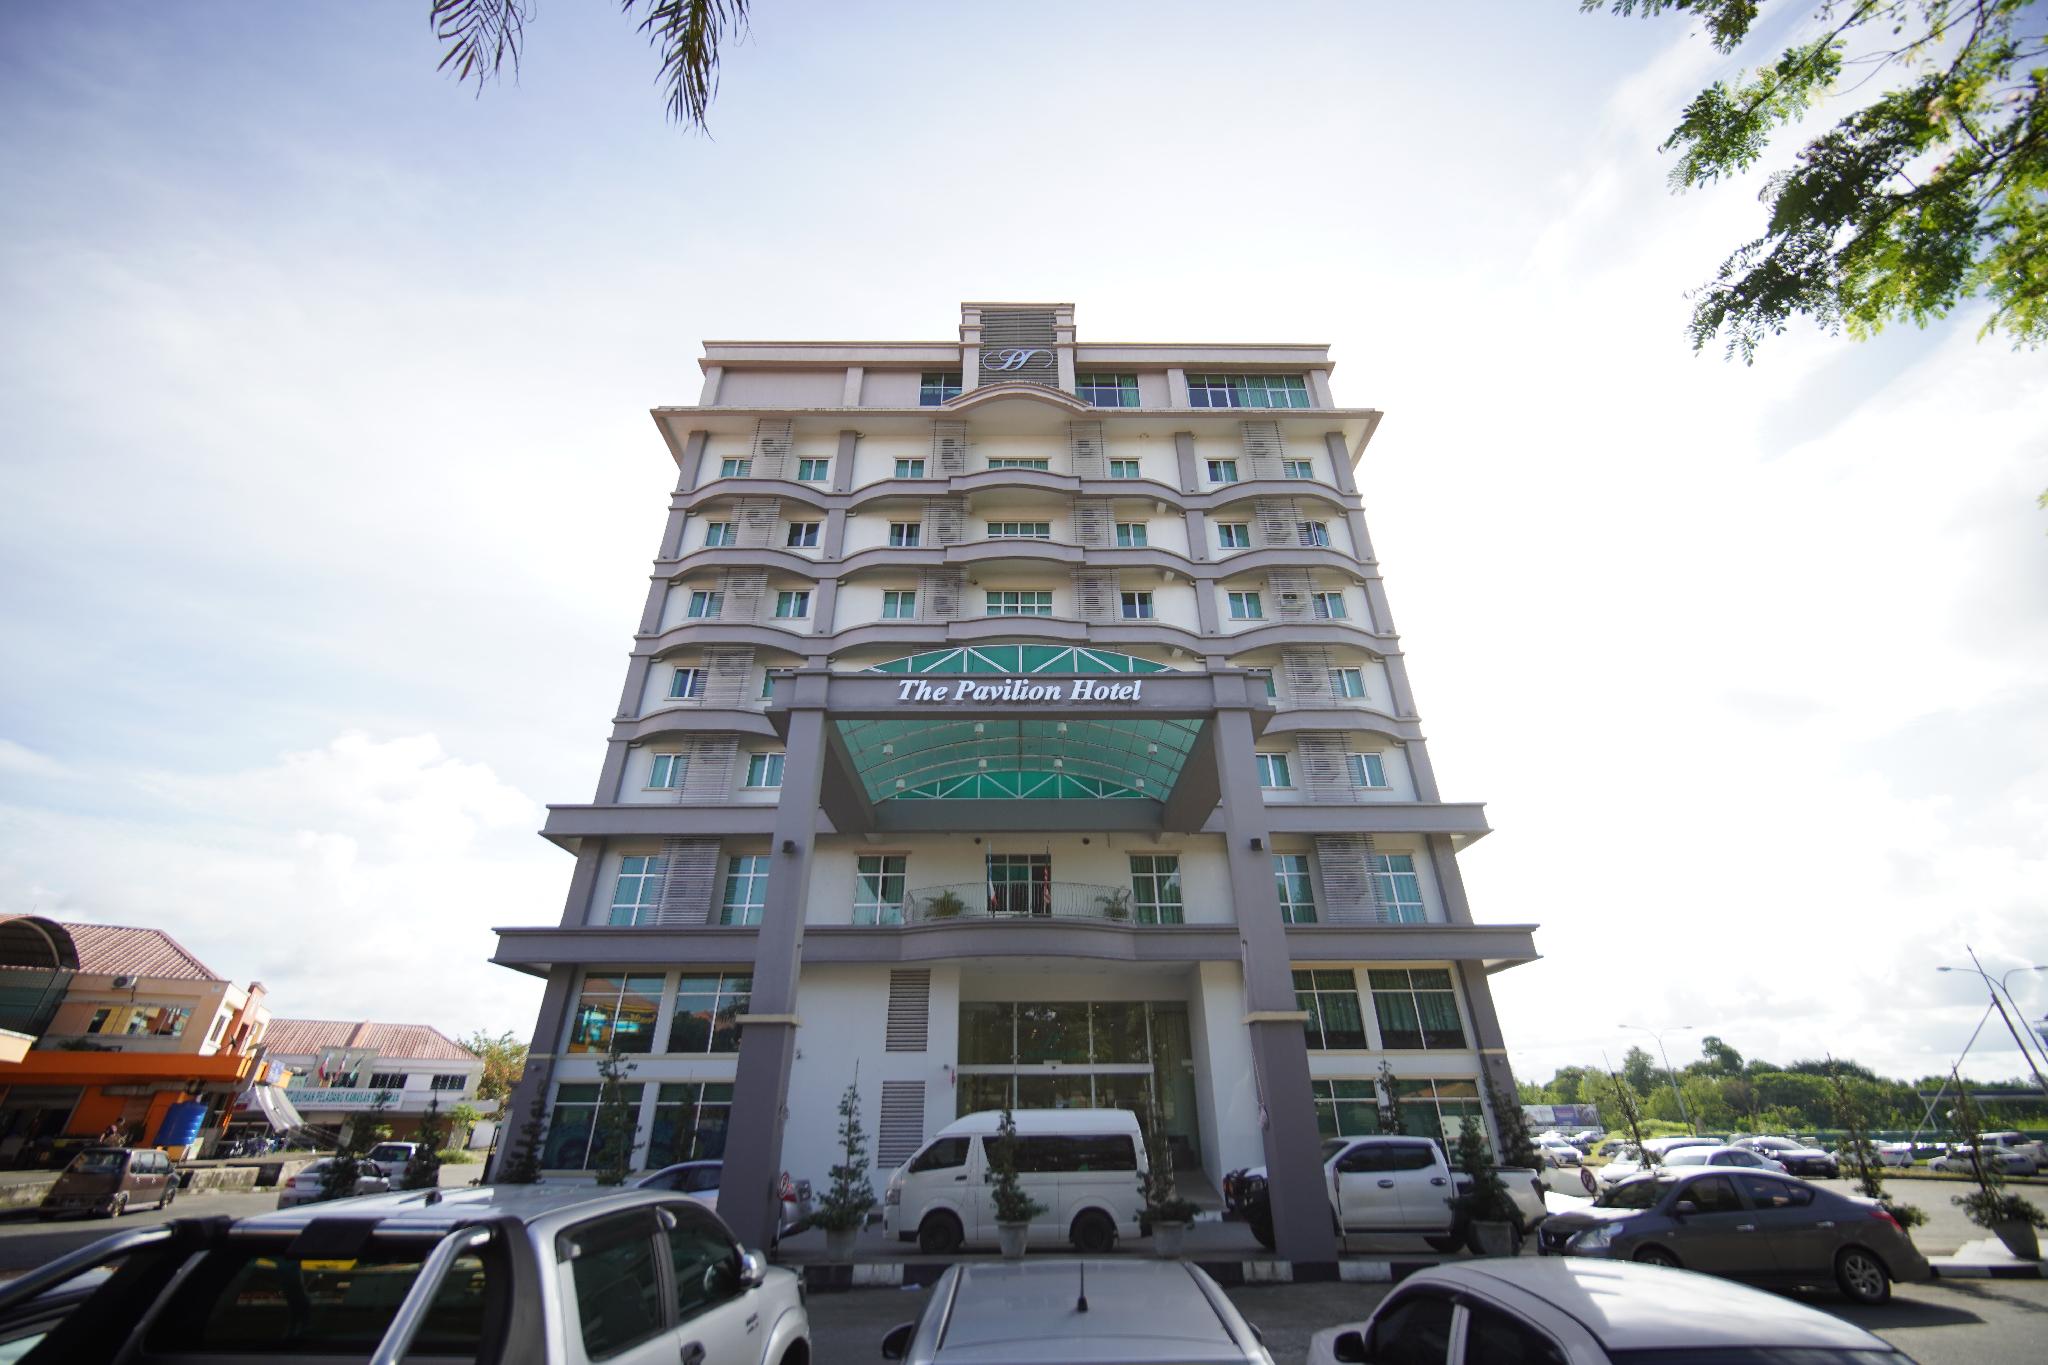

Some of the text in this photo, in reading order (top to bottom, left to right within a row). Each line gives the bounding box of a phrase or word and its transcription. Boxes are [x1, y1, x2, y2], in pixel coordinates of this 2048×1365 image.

[897, 679, 1142, 700] The Pavilion Hotel
